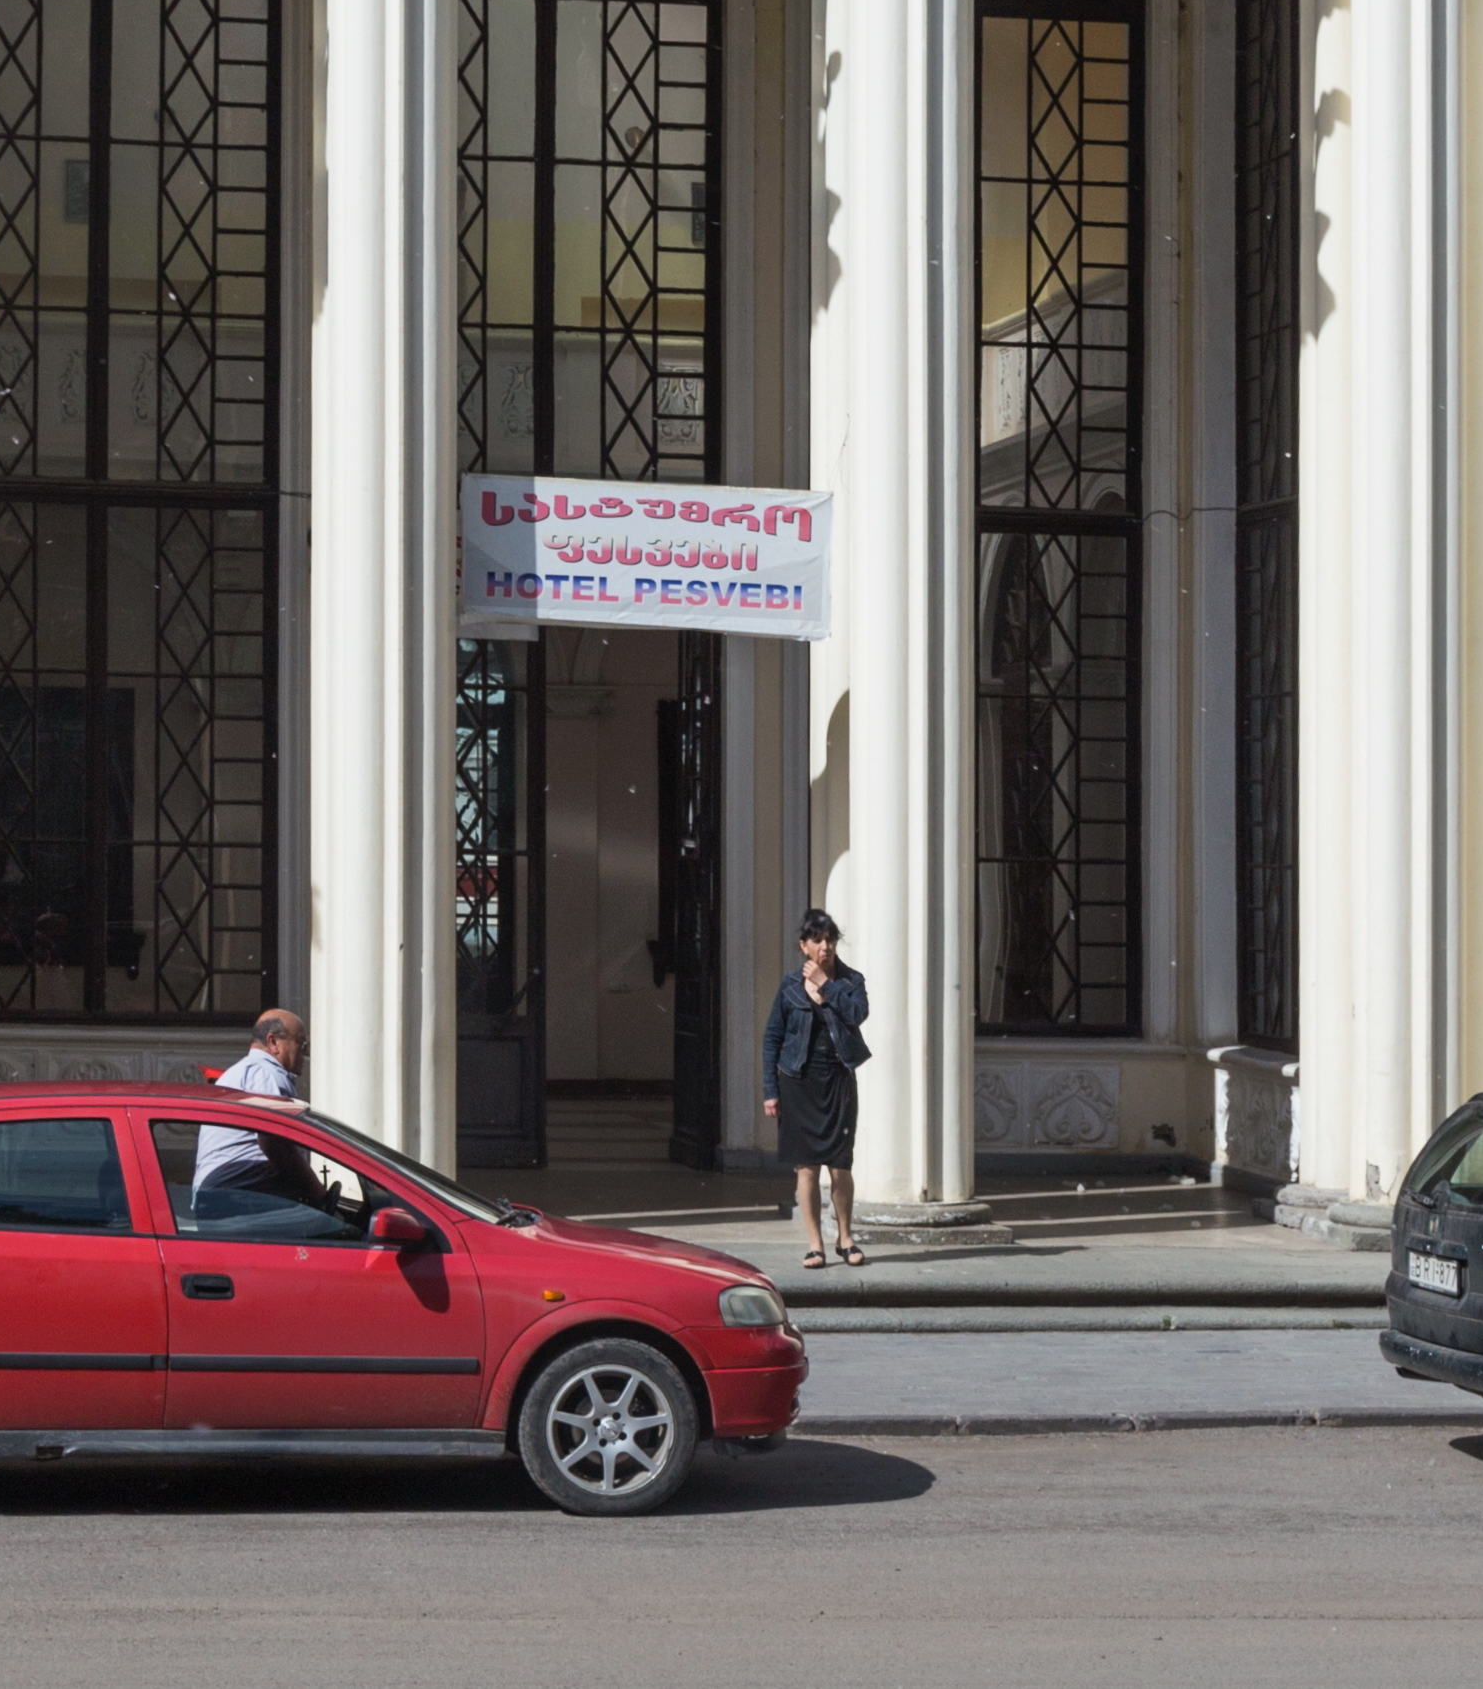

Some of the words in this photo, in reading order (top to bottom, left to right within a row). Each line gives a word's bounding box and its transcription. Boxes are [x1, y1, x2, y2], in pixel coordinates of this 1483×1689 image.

[481, 491, 812, 542] სასტუმრო
[542, 533, 759, 571] ფესვები
[485, 570, 620, 604] HOTEL
[634, 577, 803, 611] PESVEBI
